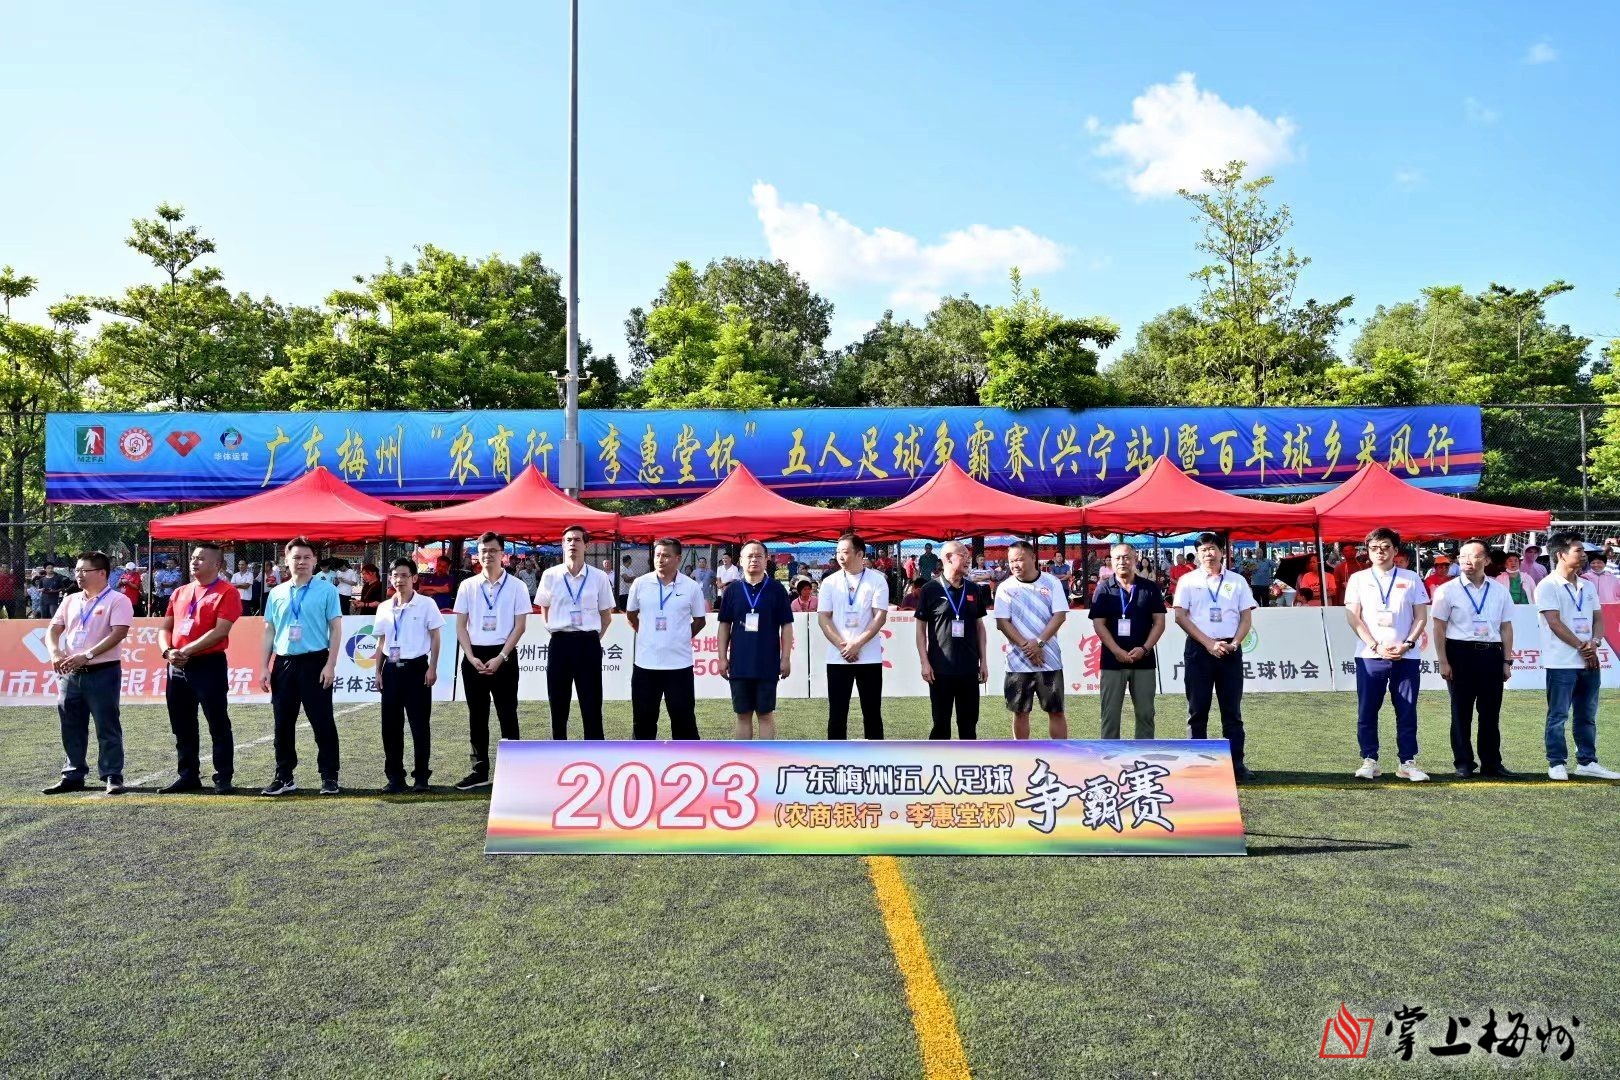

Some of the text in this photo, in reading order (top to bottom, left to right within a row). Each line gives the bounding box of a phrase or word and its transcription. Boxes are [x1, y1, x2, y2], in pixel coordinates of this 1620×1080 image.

[213, 452, 249, 462] 华体运营
[552, 761, 759, 831] 2023
[776, 764, 1015, 796] 广东梅州五人足球
[1015, 758, 1175, 833] 争霸赛
